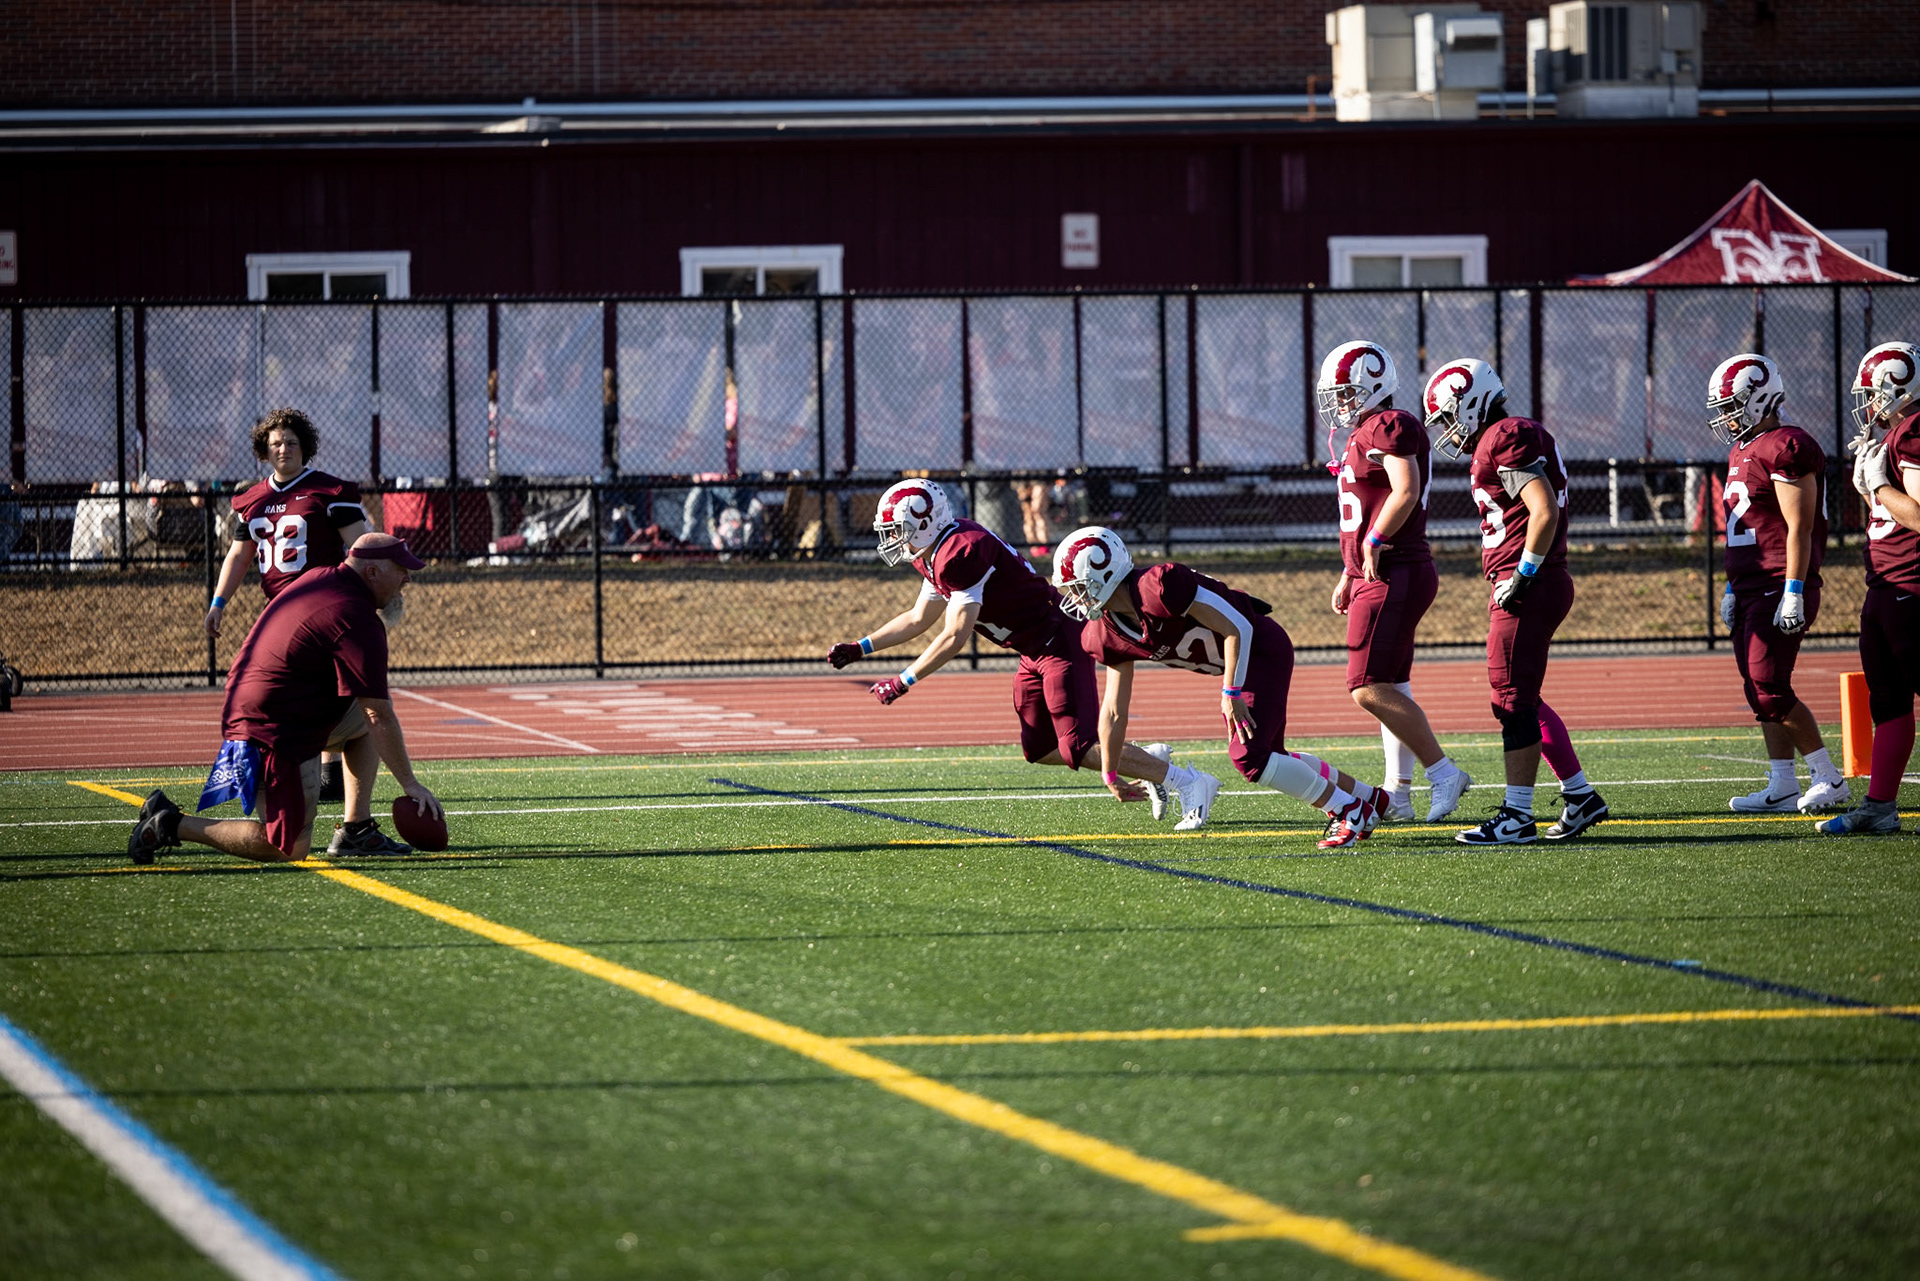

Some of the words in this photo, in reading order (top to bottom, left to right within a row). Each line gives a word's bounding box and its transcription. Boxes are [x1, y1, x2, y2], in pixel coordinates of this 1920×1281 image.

[264, 503, 287, 514] RAMS
[1337, 464, 1363, 533] 6
[1472, 487, 1506, 549] 3
[1723, 480, 1757, 547] 2
[248, 514, 308, 574] 68
